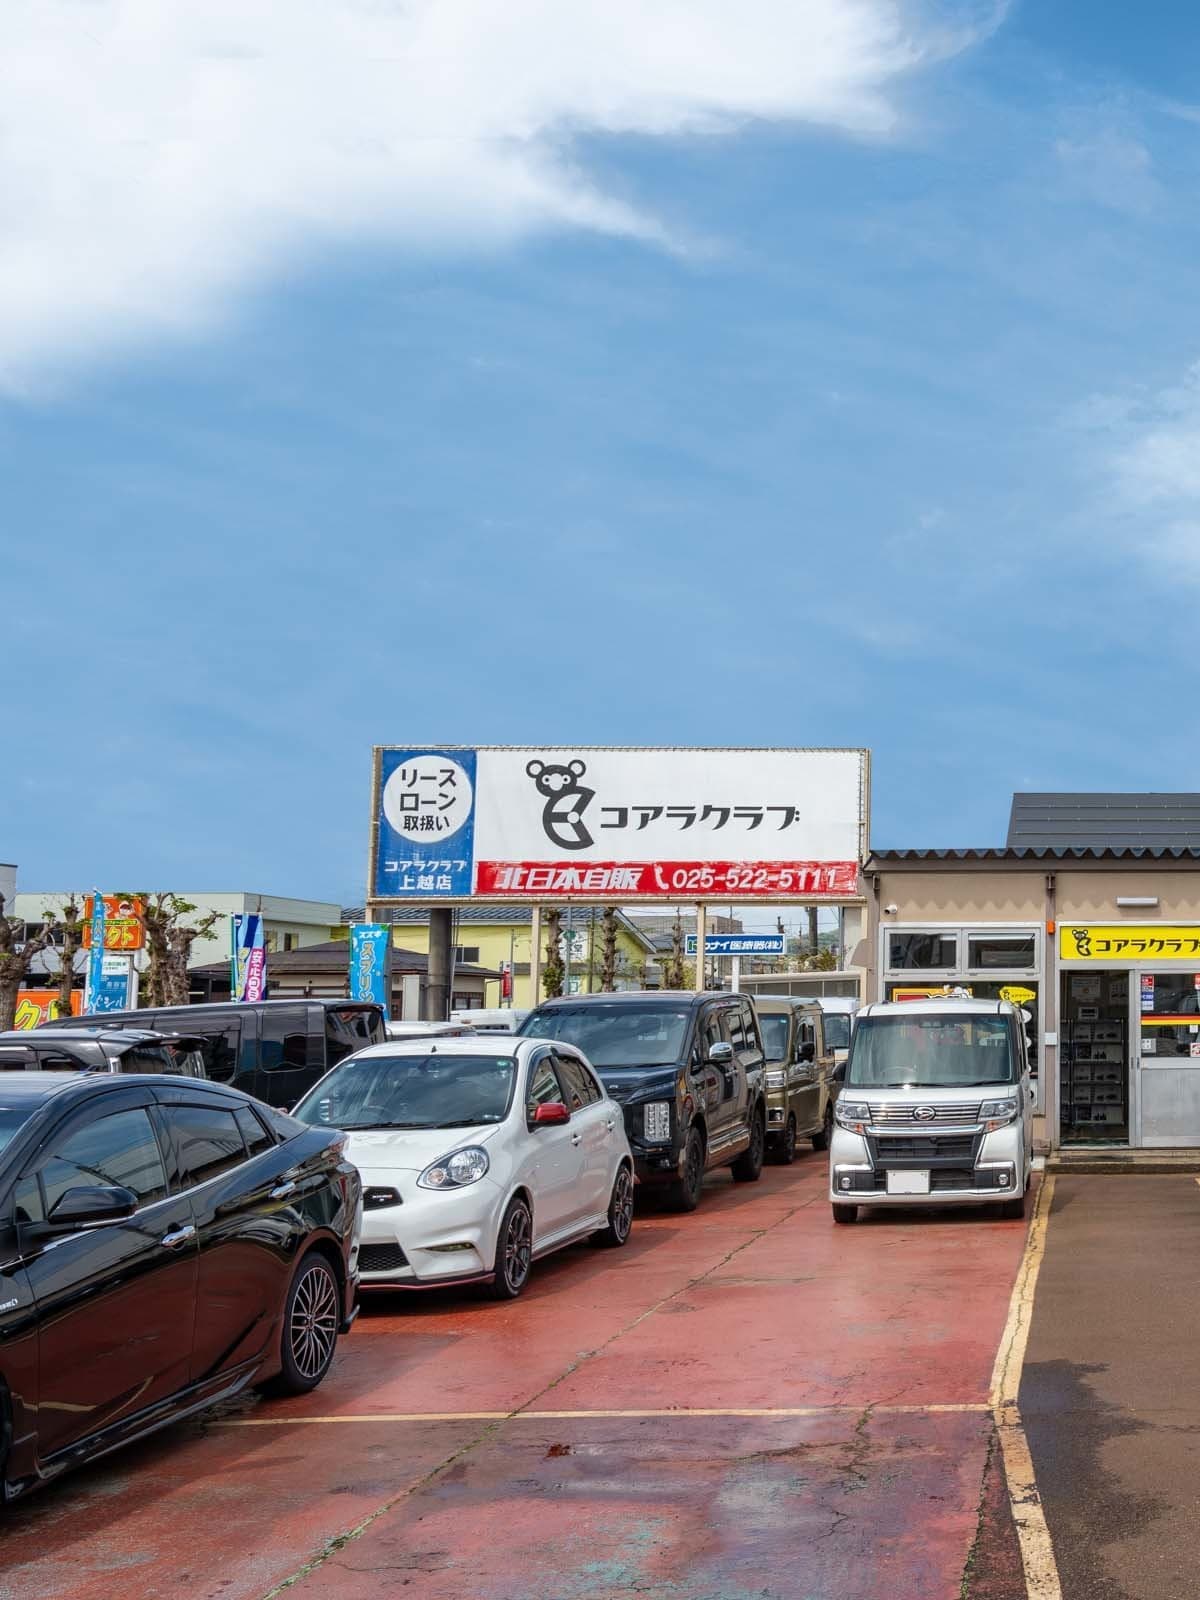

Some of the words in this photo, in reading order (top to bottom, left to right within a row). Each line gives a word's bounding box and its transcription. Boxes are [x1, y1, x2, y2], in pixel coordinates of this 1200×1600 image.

[401, 768, 457, 789] リース
[399, 792, 457, 812] ローン
[403, 815, 450, 832] 取扱い
[600, 804, 800, 831] コアラクラブ
[384, 860, 467, 872] コアラクラブ
[399, 874, 453, 890] 上越店
[494, 867, 644, 890] 北日本自販
